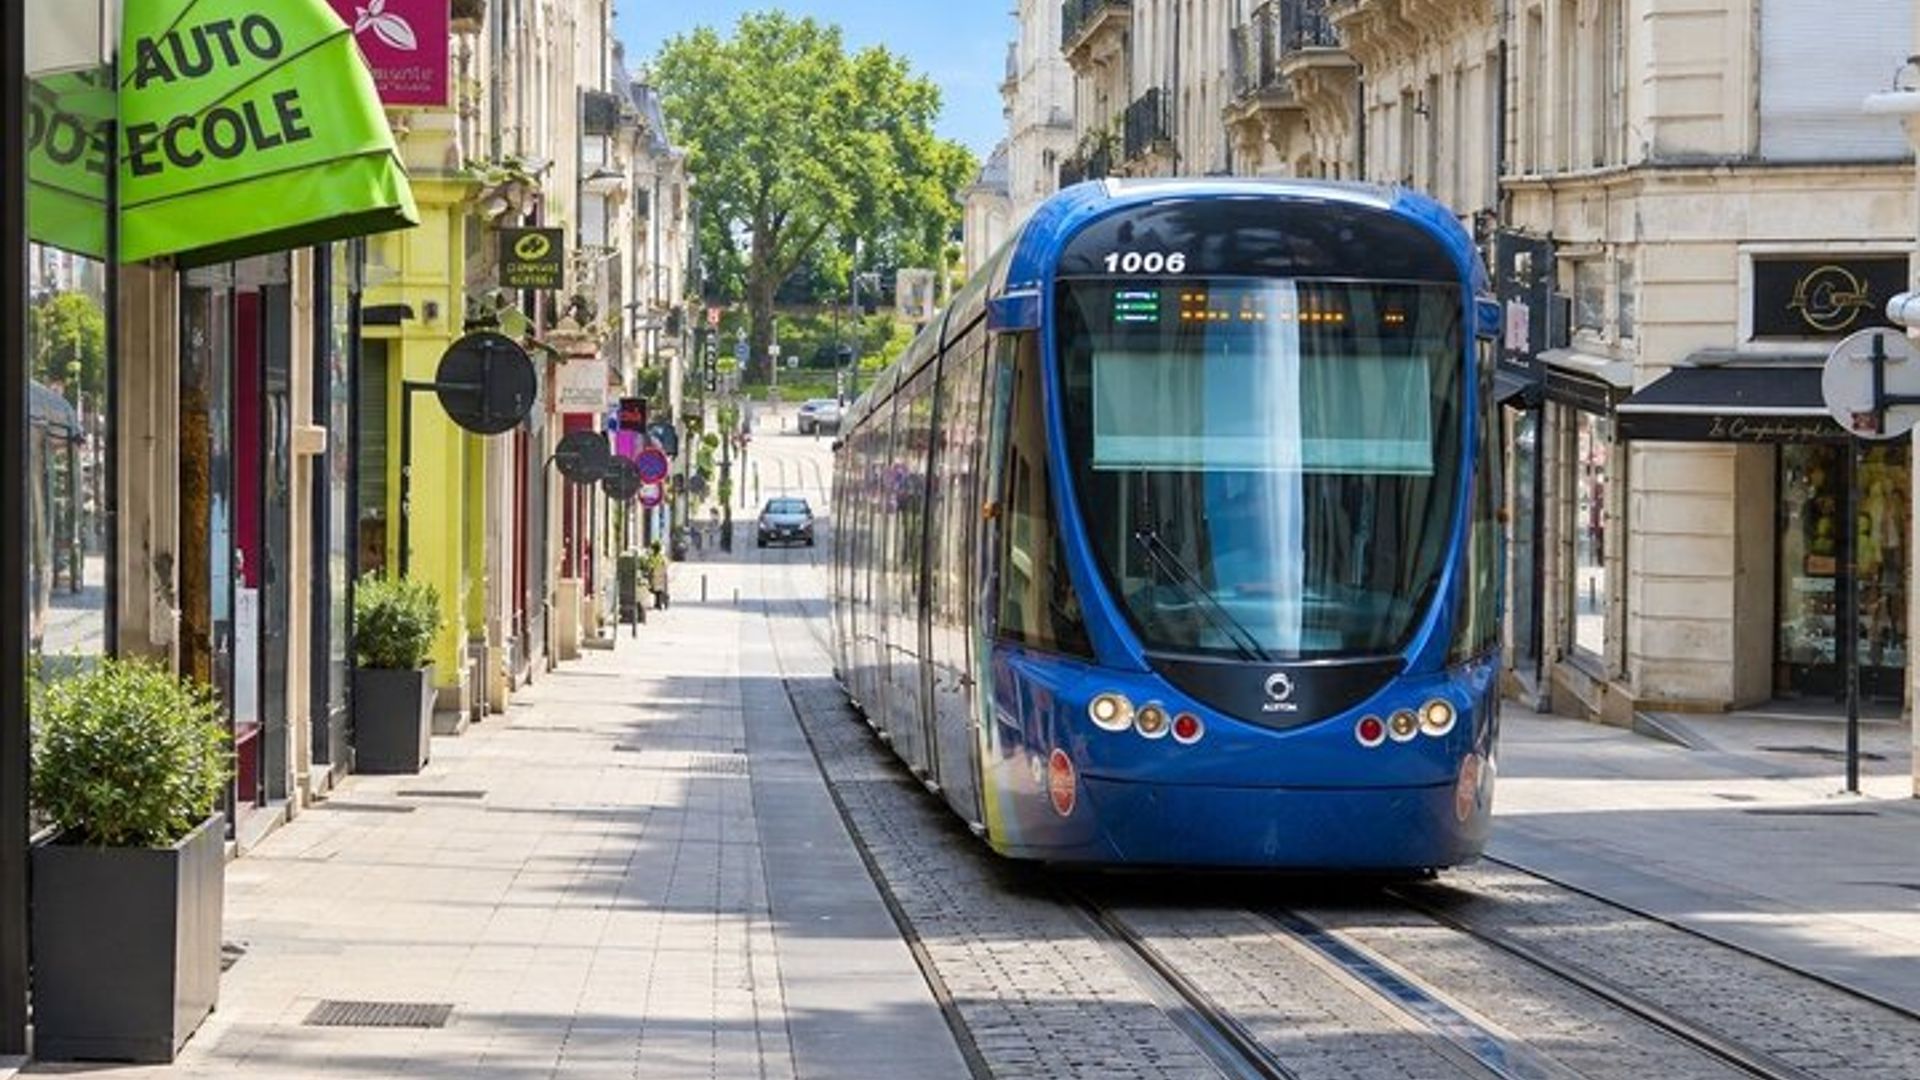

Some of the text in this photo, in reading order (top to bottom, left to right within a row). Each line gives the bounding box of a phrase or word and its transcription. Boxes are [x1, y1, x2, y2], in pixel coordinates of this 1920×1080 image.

[134, 14, 283, 90] AUTO
[126, 89, 312, 177] ECOLE
[1104, 252, 1186, 272] 1006
